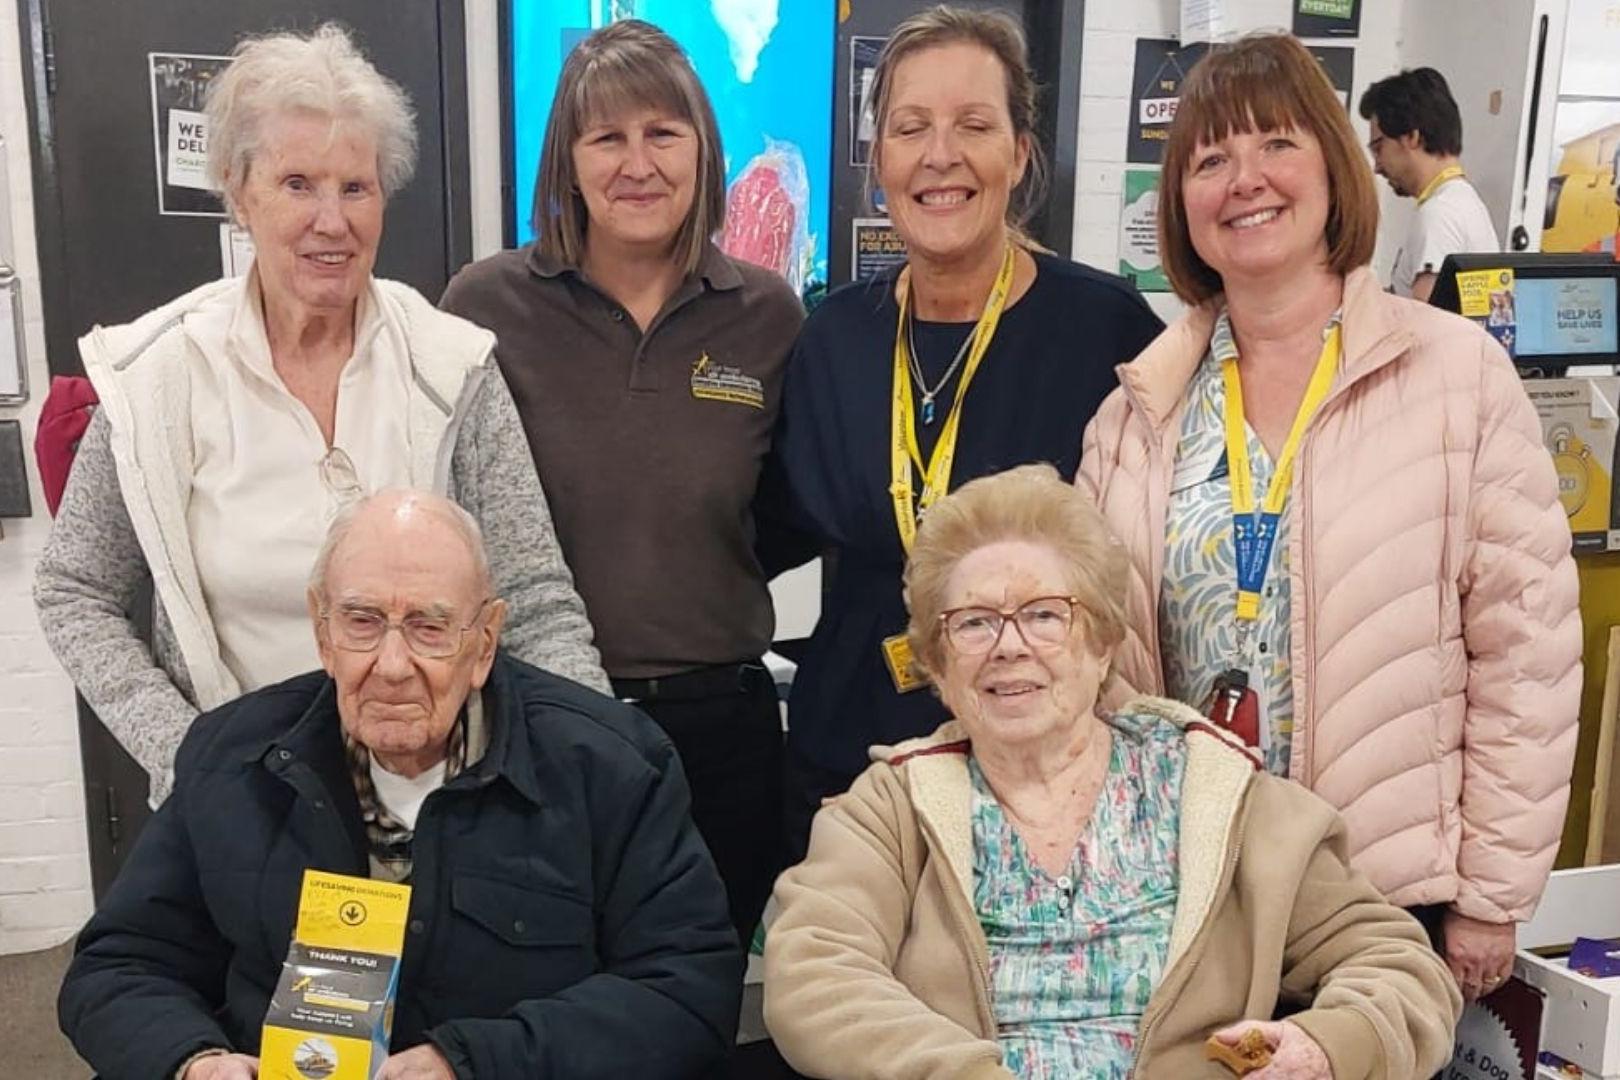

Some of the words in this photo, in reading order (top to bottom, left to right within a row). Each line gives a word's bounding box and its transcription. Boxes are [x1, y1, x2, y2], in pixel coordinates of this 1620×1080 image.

[178, 122, 204, 139] WE
[1557, 309, 1586, 320] HELP
[1588, 309, 1602, 320] US
[309, 951, 348, 963] THANK
[350, 956, 378, 968] YOU!
